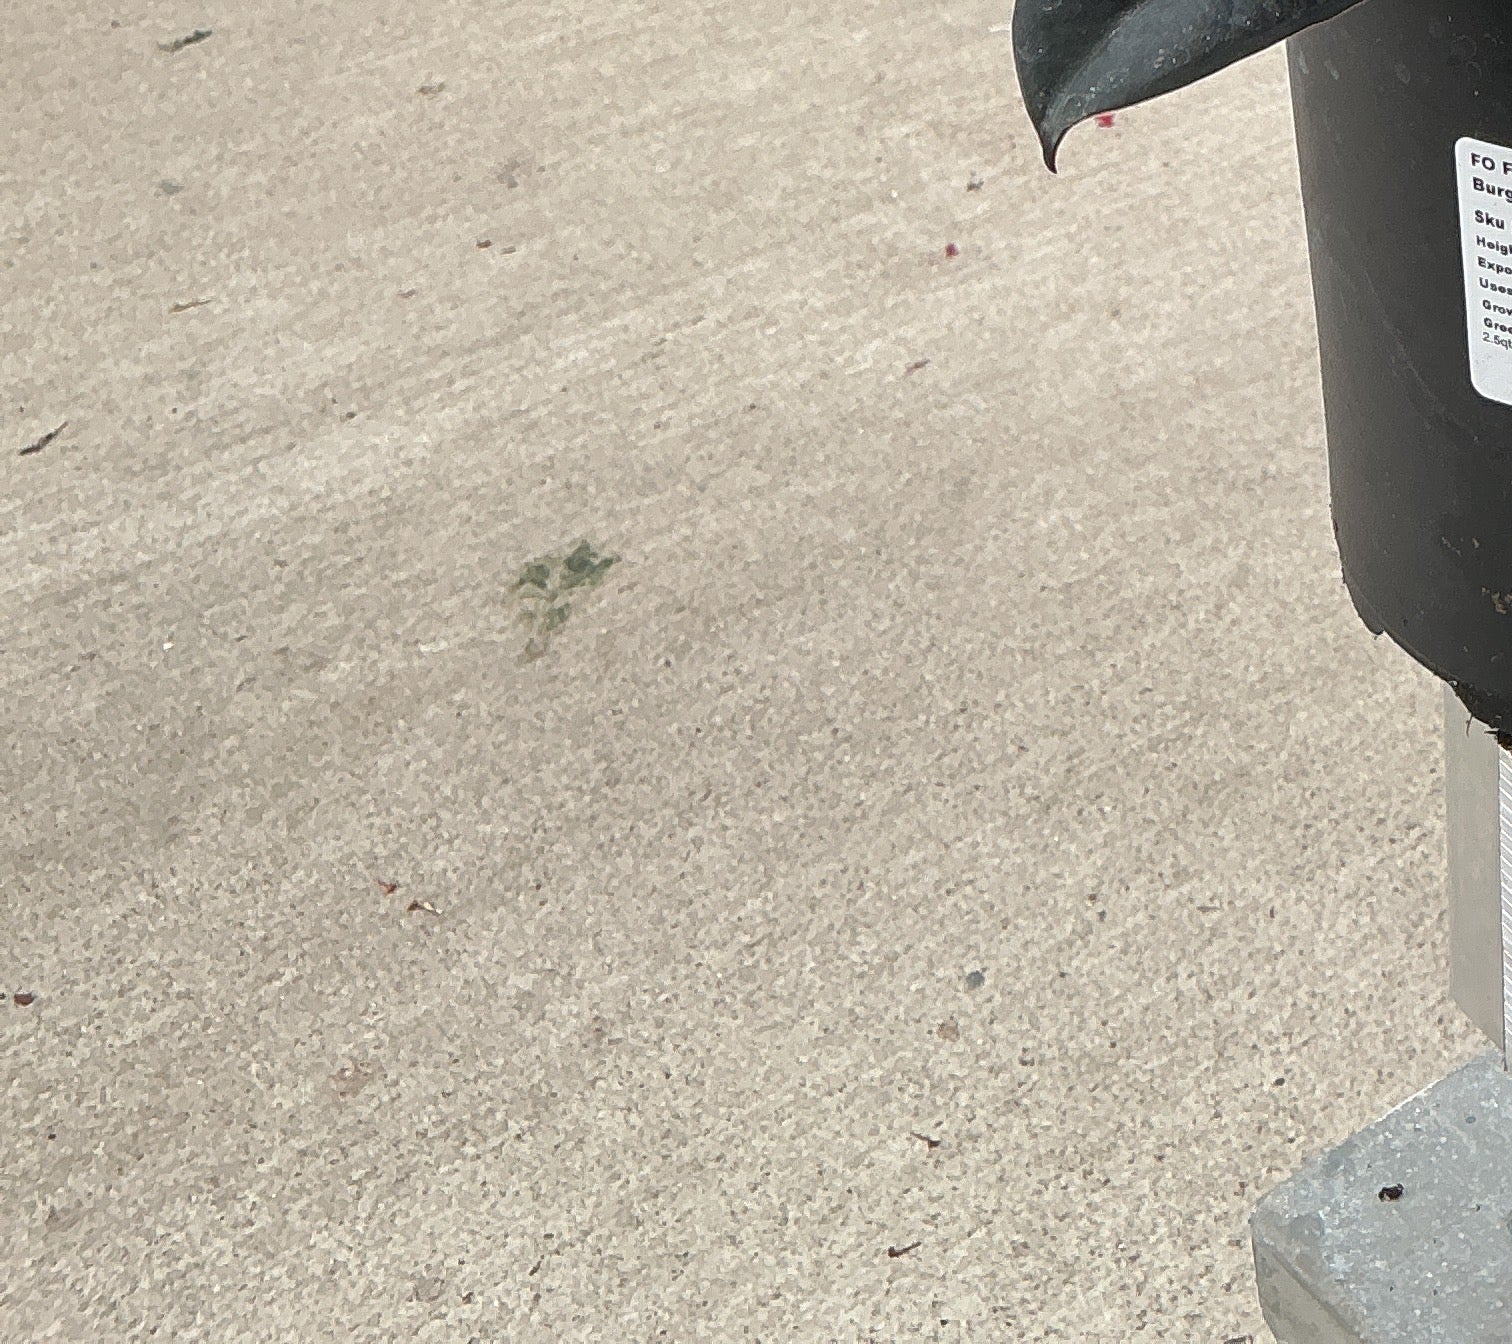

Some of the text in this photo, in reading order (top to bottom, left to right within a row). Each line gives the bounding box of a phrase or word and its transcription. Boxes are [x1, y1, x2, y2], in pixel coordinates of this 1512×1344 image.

[1470, 152, 1495, 171] FO
[1474, 210, 1505, 230] Sku
[1482, 332, 1512, 351] 2.5qt
